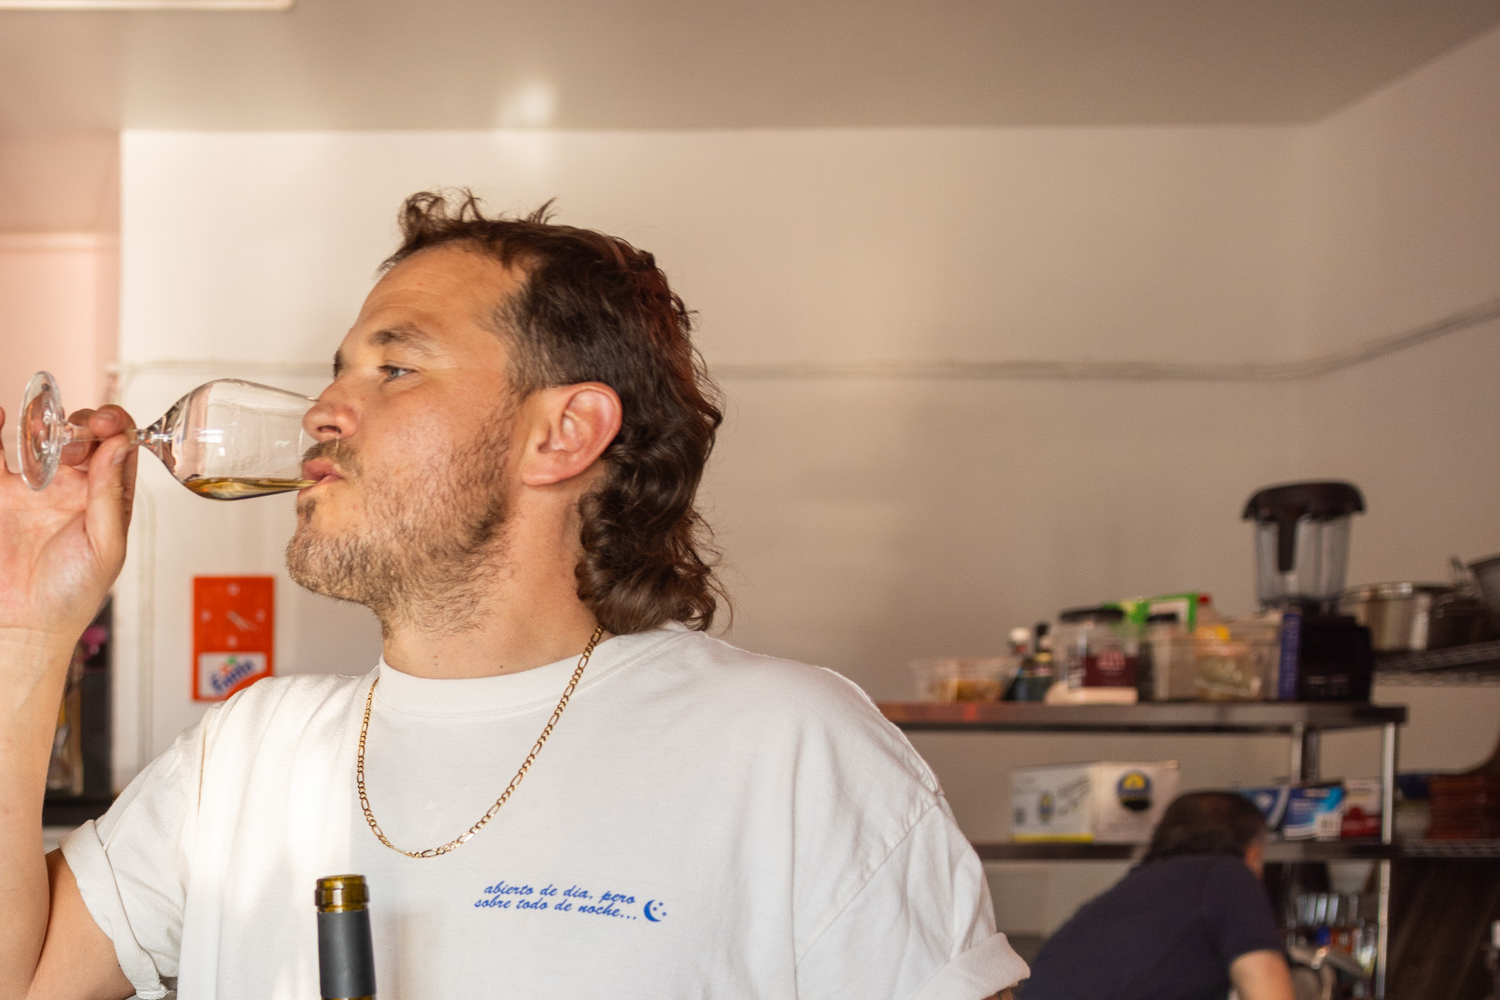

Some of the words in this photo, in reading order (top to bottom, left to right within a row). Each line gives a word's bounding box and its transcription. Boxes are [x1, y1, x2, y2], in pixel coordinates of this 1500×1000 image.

[483, 880, 534, 896] abierto
[540, 883, 558, 897] de
[599, 890, 636, 904] pero
[474, 895, 511, 909] sobre
[516, 897, 548, 910] todo
[554, 899, 573, 912] de
